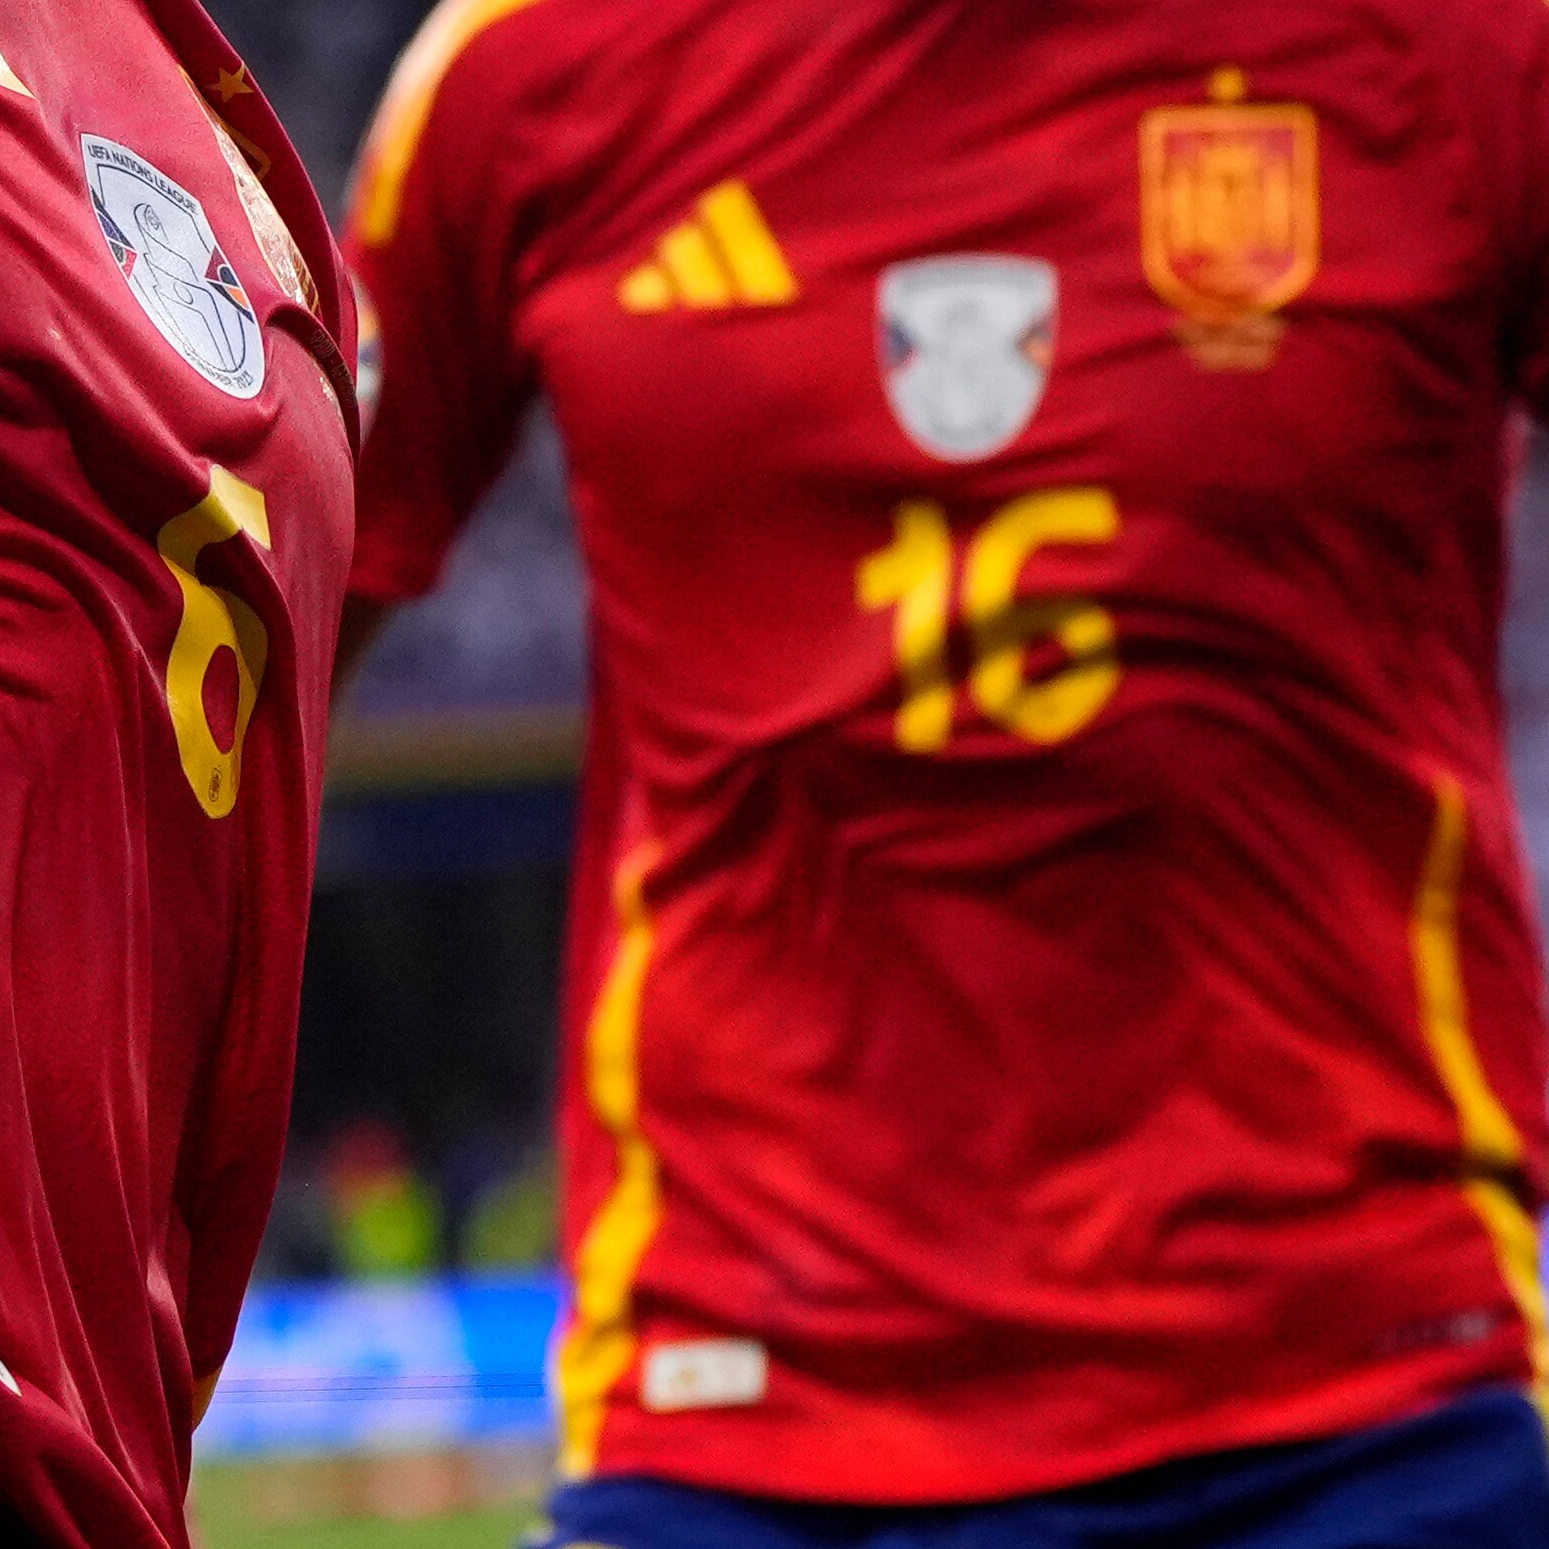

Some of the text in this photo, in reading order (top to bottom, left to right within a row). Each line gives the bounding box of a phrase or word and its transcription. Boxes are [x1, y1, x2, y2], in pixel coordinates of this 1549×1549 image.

[87, 144, 200, 216] UEFA NATIONS LEAGUE
[157, 463, 272, 818] 6
[855, 484, 1122, 752] 16
